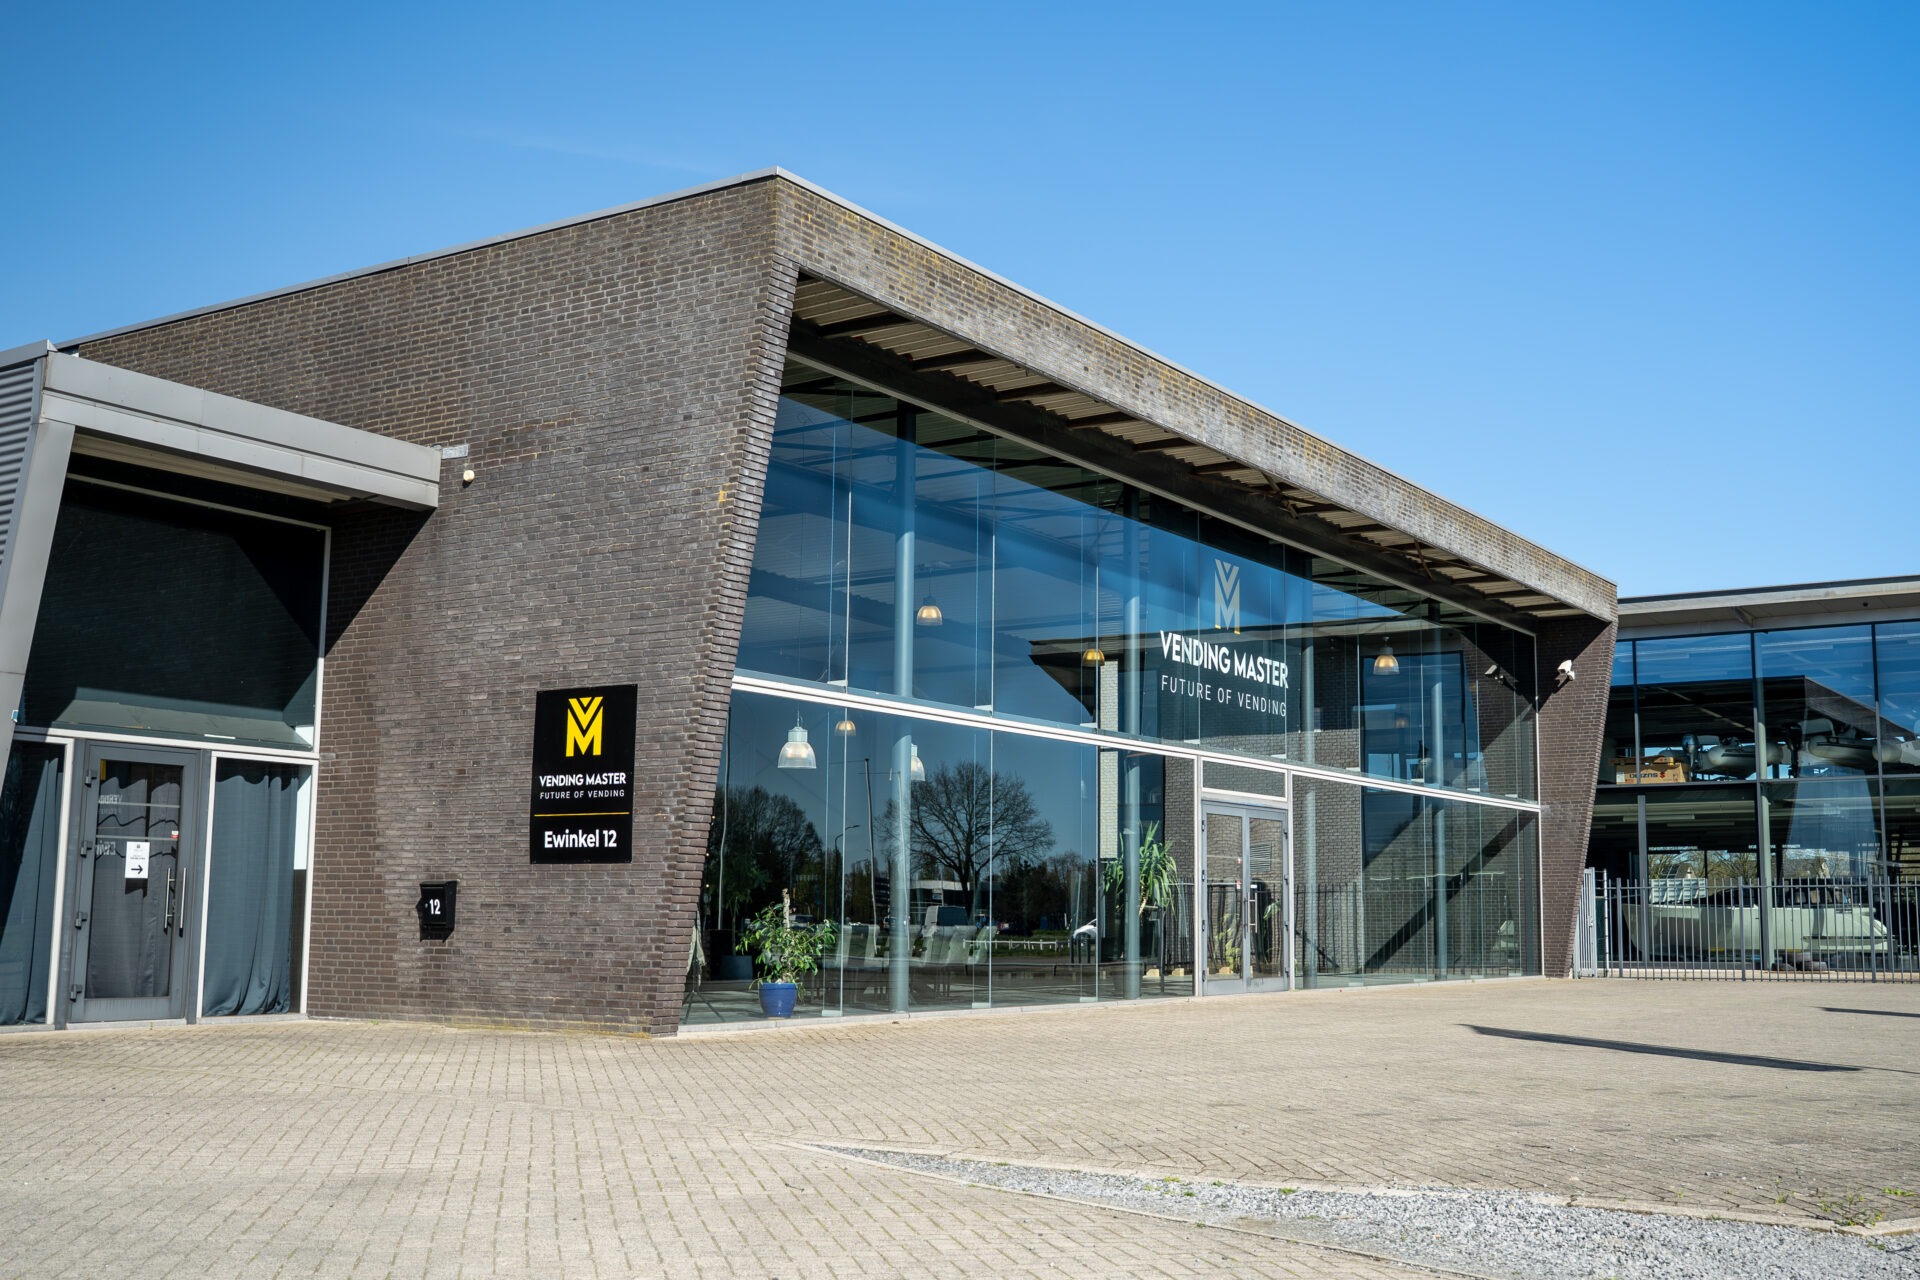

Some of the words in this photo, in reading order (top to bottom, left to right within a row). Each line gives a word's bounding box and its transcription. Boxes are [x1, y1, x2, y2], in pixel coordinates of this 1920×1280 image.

[1159, 630, 1231, 674] VENDING
[1234, 649, 1289, 689] MASTER
[1161, 674, 1212, 701] FUTURE
[1217, 687, 1232, 705] OF
[1237, 691, 1287, 717] VENDING
[539, 773, 584, 787] VENDING
[585, 772, 627, 785] MASTER
[539, 791, 571, 800] FUTURE
[573, 790, 585, 799] OF
[587, 789, 625, 798] VENDING
[543, 828, 600, 849] Ewinkel
[602, 830, 617, 848] 12
[429, 898, 441, 915] 12
